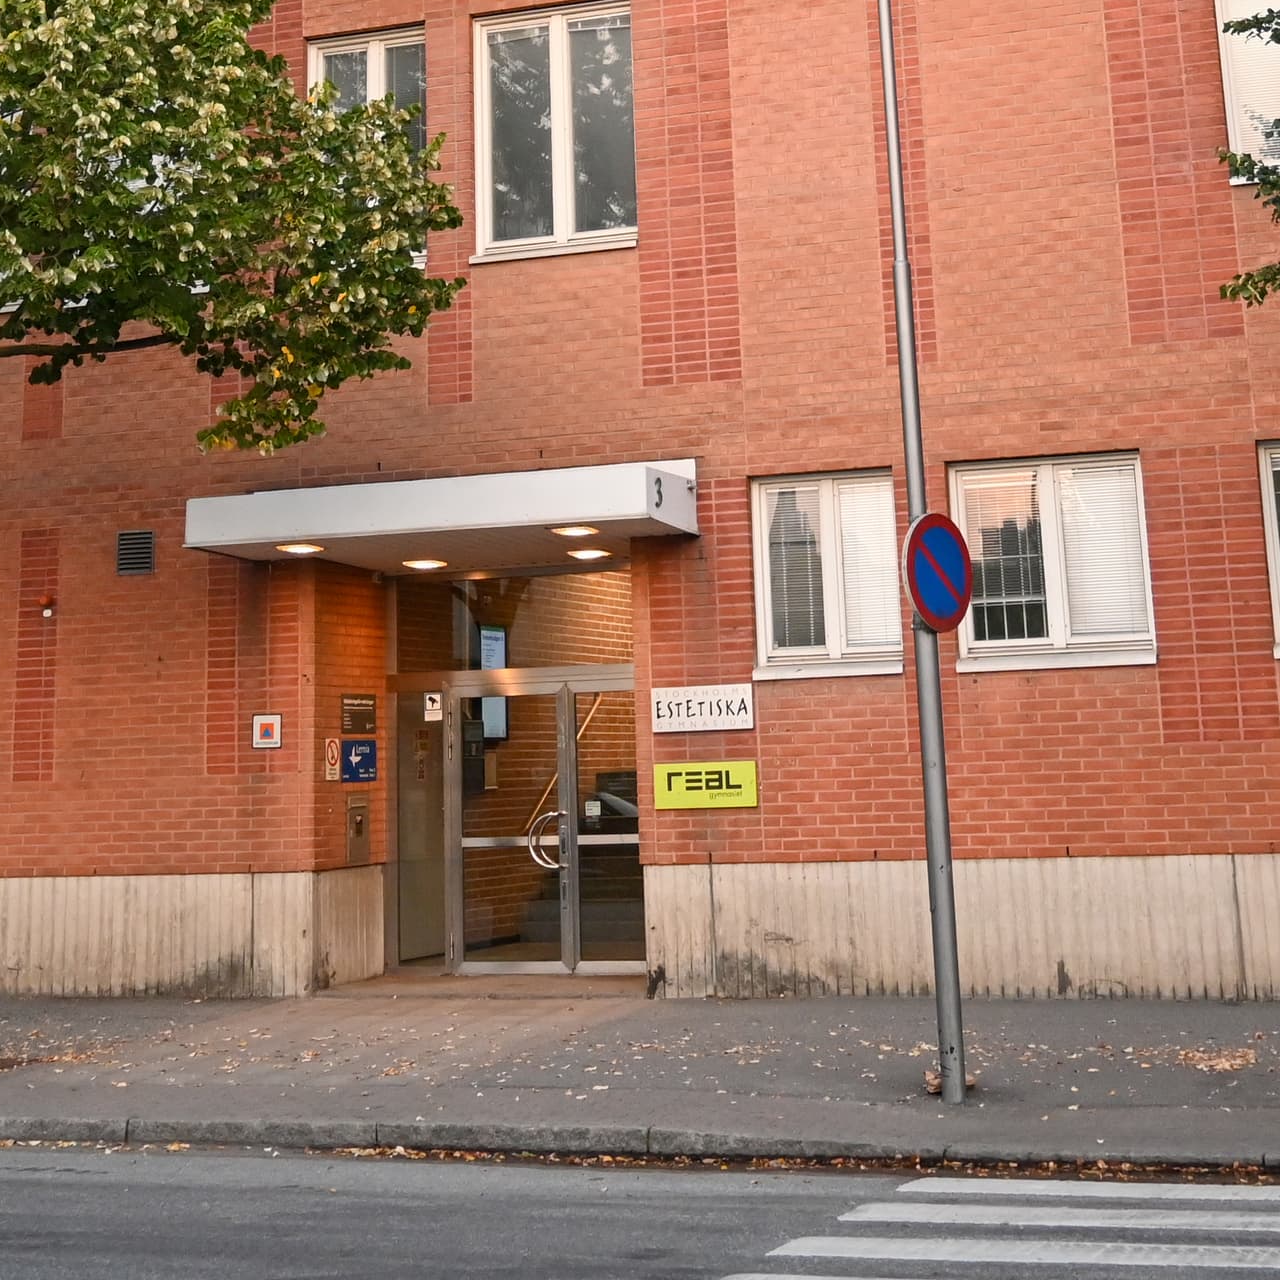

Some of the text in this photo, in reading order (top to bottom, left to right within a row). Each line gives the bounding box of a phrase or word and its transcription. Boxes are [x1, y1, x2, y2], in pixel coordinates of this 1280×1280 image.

[654, 477, 663, 508] 3
[656, 687, 748, 699] STOCKHOLMS
[656, 698, 748, 719] ESTETISKA
[656, 719, 749, 730] GYMNASIUM
